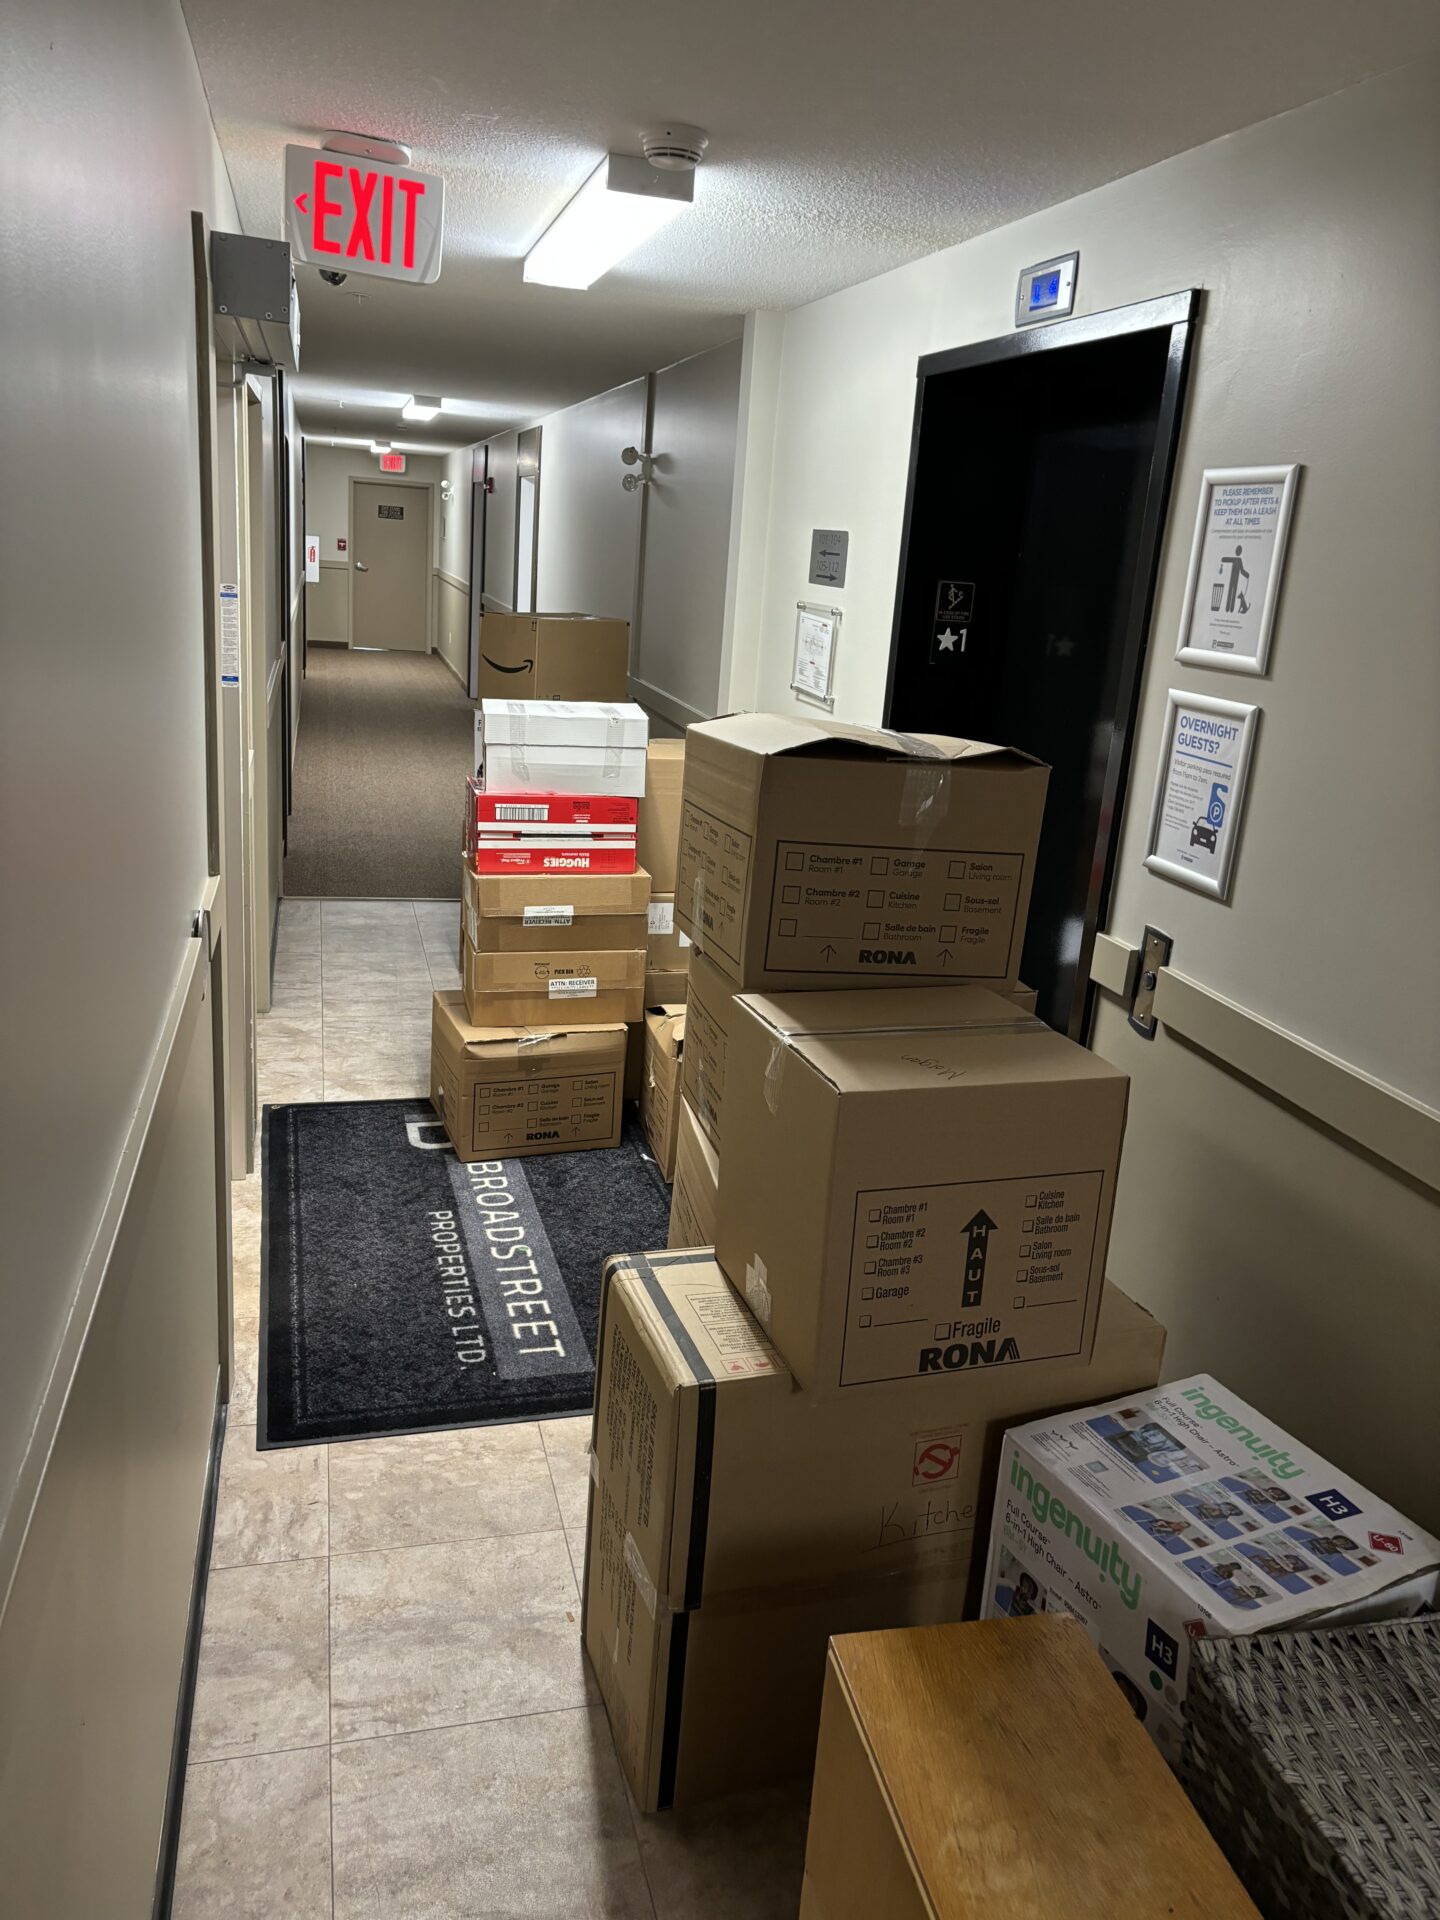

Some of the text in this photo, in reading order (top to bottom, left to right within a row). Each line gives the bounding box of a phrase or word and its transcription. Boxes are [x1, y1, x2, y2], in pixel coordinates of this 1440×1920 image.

[311, 159, 426, 269] EXIT
[1222, 487, 1274, 496] PLEASE REMEMBER
[1222, 498, 1242, 506] PICKUP
[1241, 497, 1260, 505] AFTER
[1260, 497, 1275, 505] PETS
[1214, 508, 1228, 516] KEEP
[1228, 508, 1243, 516] THEM
[1257, 507, 1277, 515] LEASH
[959, 628, 967, 652] 1
[1180, 715, 1239, 741] OVERNIGHT
[1177, 732, 1220, 754] GUESTS?
[543, 858, 590, 868] HUGGIES
[809, 854, 863, 866] Chambre #1
[893, 859, 926, 870] Garage
[808, 865, 844, 874] Room #1
[892, 868, 923, 878] Garage
[969, 862, 993, 872] Salon
[967, 871, 992, 882] Living
[805, 887, 861, 899] Chambre #2
[889, 891, 920, 901] Cuisine
[804, 897, 841, 907] Room #2
[887, 900, 917, 909] Kitchen
[964, 895, 1000, 906] Sous-sol
[963, 905, 1002, 914] Basement
[884, 923, 936, 933] Salle de bain
[961, 926, 990, 938] Fragile
[883, 932, 922, 941] Bathroom
[960, 935, 986, 945] Fragile
[858, 949, 917, 965] RONA
[526, 1130, 560, 1141] RONA
[1039, 1190, 1065, 1201] Cuisine
[883, 1202, 928, 1215] Chambre #1
[1037, 1199, 1065, 1210] Kitchen
[882, 1213, 915, 1225] Room #1
[1035, 1213, 1080, 1226] Salle de bain
[880, 1228, 926, 1241] Chambre #2
[1034, 1223, 1069, 1234] Bathroom
[879, 1239, 913, 1251] Room #2
[1032, 1241, 1053, 1251] Salon
[466, 1160, 566, 1358] BROADSTREET
[1031, 1247, 1072, 1260] Living room
[878, 1254, 923, 1268] Chambre #3
[968, 1224, 986, 1303] HAUT
[877, 1265, 910, 1277] Room #3
[1029, 1264, 1060, 1275] Sous-sol
[1028, 1272, 1064, 1284] Basement
[428, 1209, 487, 1371] PROPERTIES LTD.
[875, 1285, 910, 1299] Garage
[952, 1317, 1001, 1340] Fragile
[918, 1337, 1021, 1373] RONA
[1162, 1395, 1176, 1409] Full
[1180, 1386, 1305, 1479] ingenuity
[1175, 1415, 1190, 1431] High
[1189, 1428, 1209, 1444] Chair
[1214, 1449, 1236, 1467] Astro
[1319, 1496, 1349, 1515] H3
[1006, 1499, 1020, 1518] Full
[1021, 1509, 1048, 1545] Course
[1010, 1449, 1142, 1611] ingenuity
[1005, 1512, 1027, 1538] 6-in-1
[1027, 1536, 1045, 1556] High
[1045, 1552, 1067, 1578] Chair
[1074, 1581, 1099, 1610] Astro
[1151, 1634, 1174, 1666] H3
